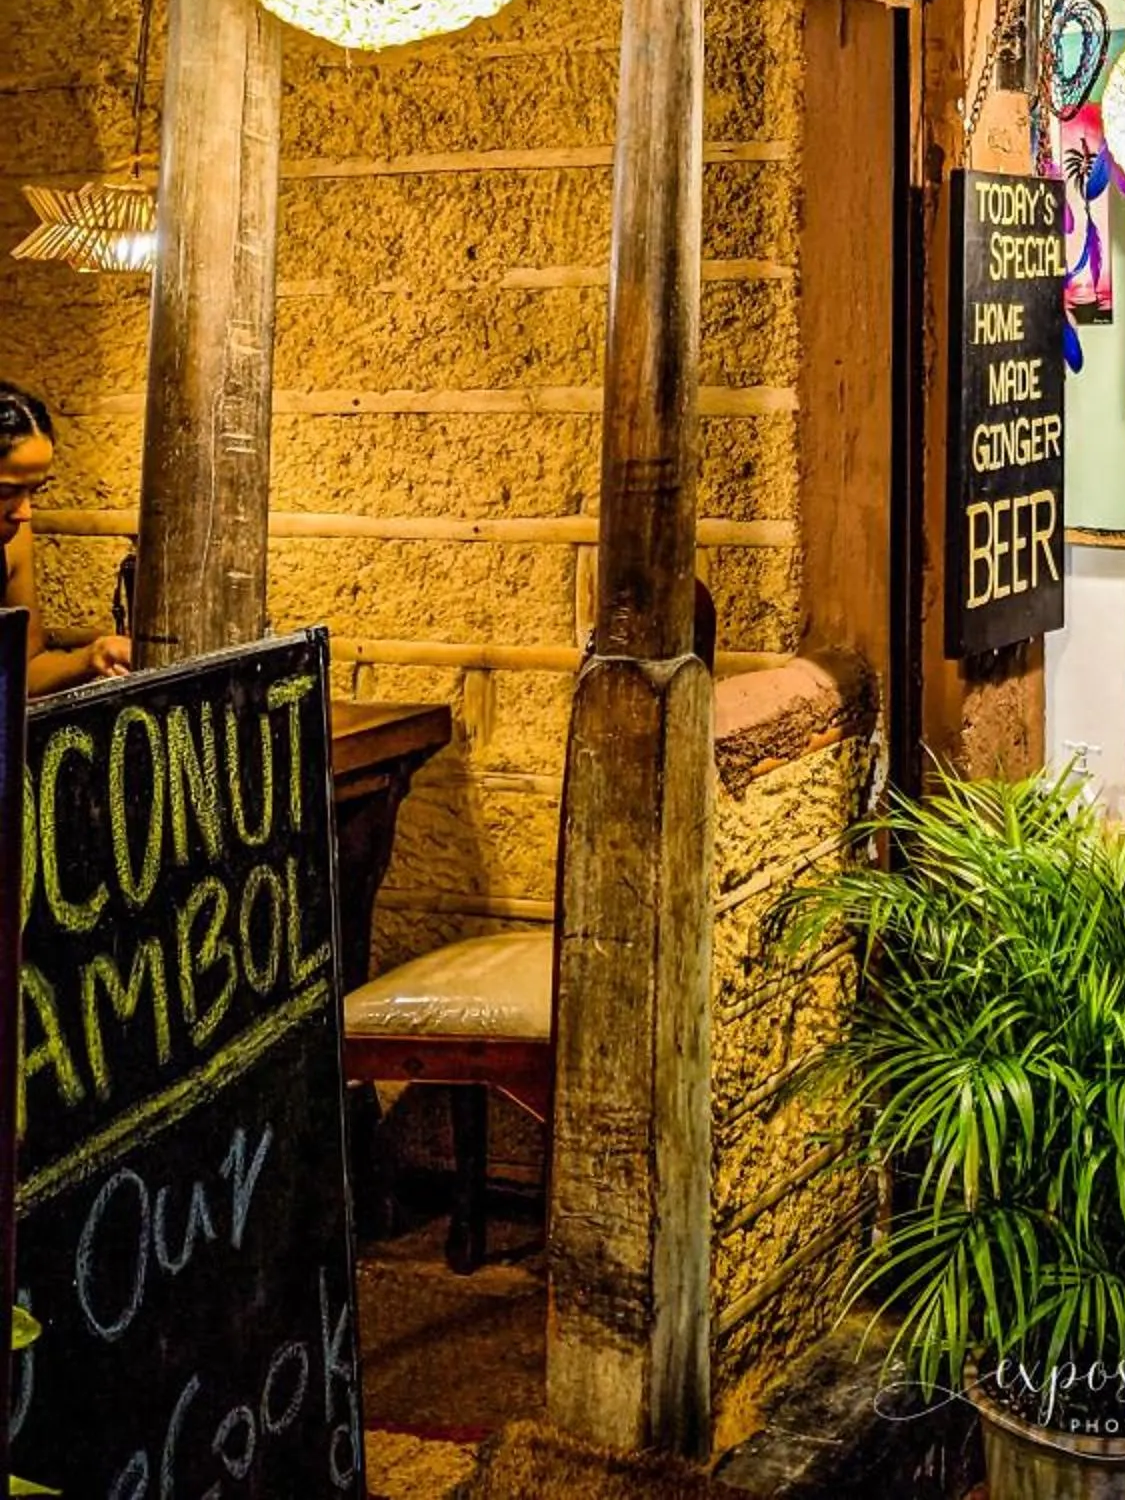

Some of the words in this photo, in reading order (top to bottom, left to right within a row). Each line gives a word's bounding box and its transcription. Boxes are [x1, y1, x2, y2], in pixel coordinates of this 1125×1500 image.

[975, 181, 1057, 226] TODAY'S
[989, 231, 1066, 281] SPECIAL
[972, 303, 1025, 346] HOME
[988, 358, 1042, 406] MADE
[971, 416, 1062, 473] GINGER
[965, 488, 1060, 610] BEER
[76, 1121, 274, 1342] Our
